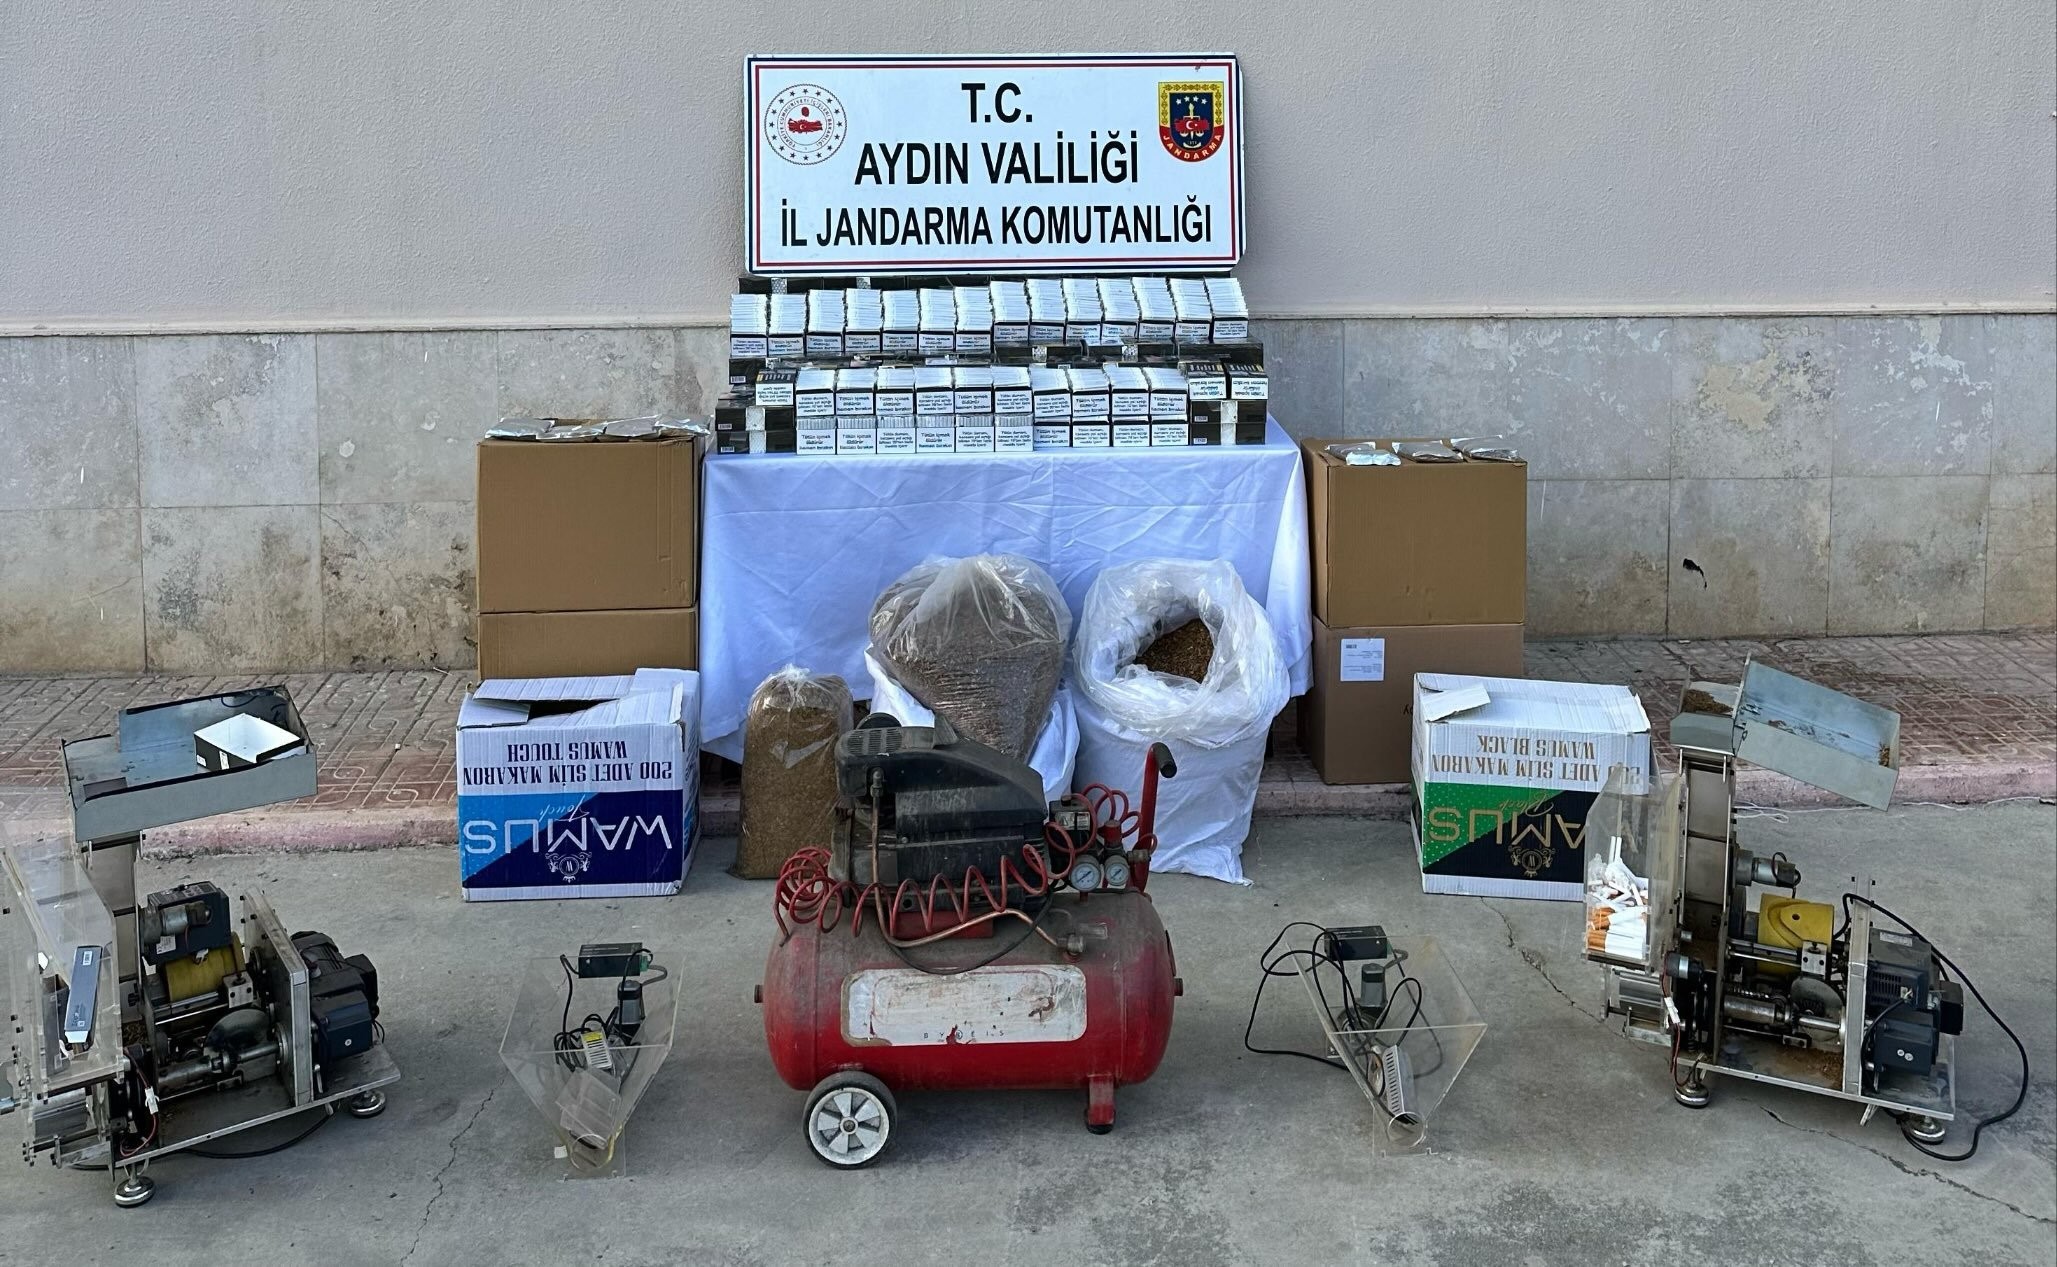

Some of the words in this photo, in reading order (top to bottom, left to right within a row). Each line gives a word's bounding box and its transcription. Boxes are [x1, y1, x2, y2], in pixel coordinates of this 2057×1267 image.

[961, 82, 1034, 124] T.C.
[854, 142, 969, 185] AYDIN
[981, 130, 1138, 184] VALİLİĞİ
[1162, 134, 1222, 160] JANDARMA
[781, 198, 807, 247] İL
[817, 207, 994, 248] JANDARMA
[1002, 194, 1211, 246] KOMUTANLIĞI
[507, 742, 564, 763] TOUCH
[568, 741, 628, 760] WAMUS
[1477, 735, 1530, 756] BLACK
[1536, 739, 1595, 760] WAMUS
[592, 763, 635, 782] ADET
[639, 761, 672, 780] 200
[1431, 754, 1509, 776] MAKARON
[1559, 762, 1600, 782] ADET
[463, 766, 542, 786] MAKARON
[538, 794, 590, 823] Touch
[463, 815, 673, 854] WAMUS
[1428, 807, 1587, 849] AMUS
